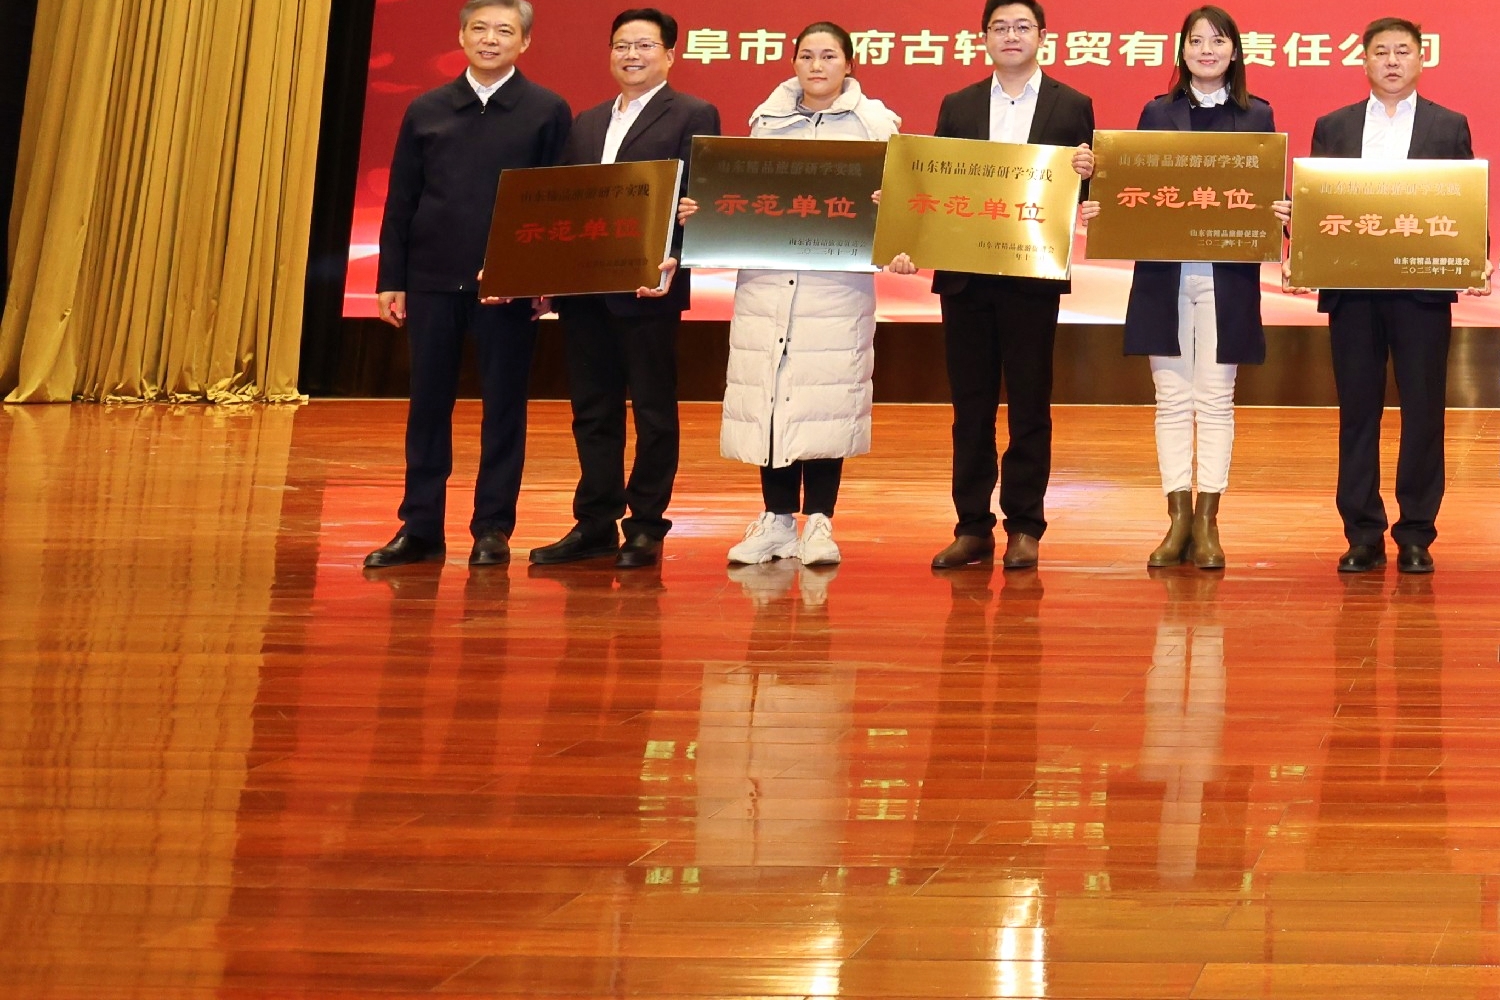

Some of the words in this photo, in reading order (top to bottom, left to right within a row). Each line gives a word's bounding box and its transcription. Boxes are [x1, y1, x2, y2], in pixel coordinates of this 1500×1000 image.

[1119, 154, 1260, 169] 山东精品旅游研学实践
[715, 194, 857, 219] 示范单位
[908, 193, 1046, 223] 示范单位
[1116, 185, 1257, 210] 示范单位
[515, 218, 641, 243] 示范单位
[1319, 213, 1459, 237] 示范单位
